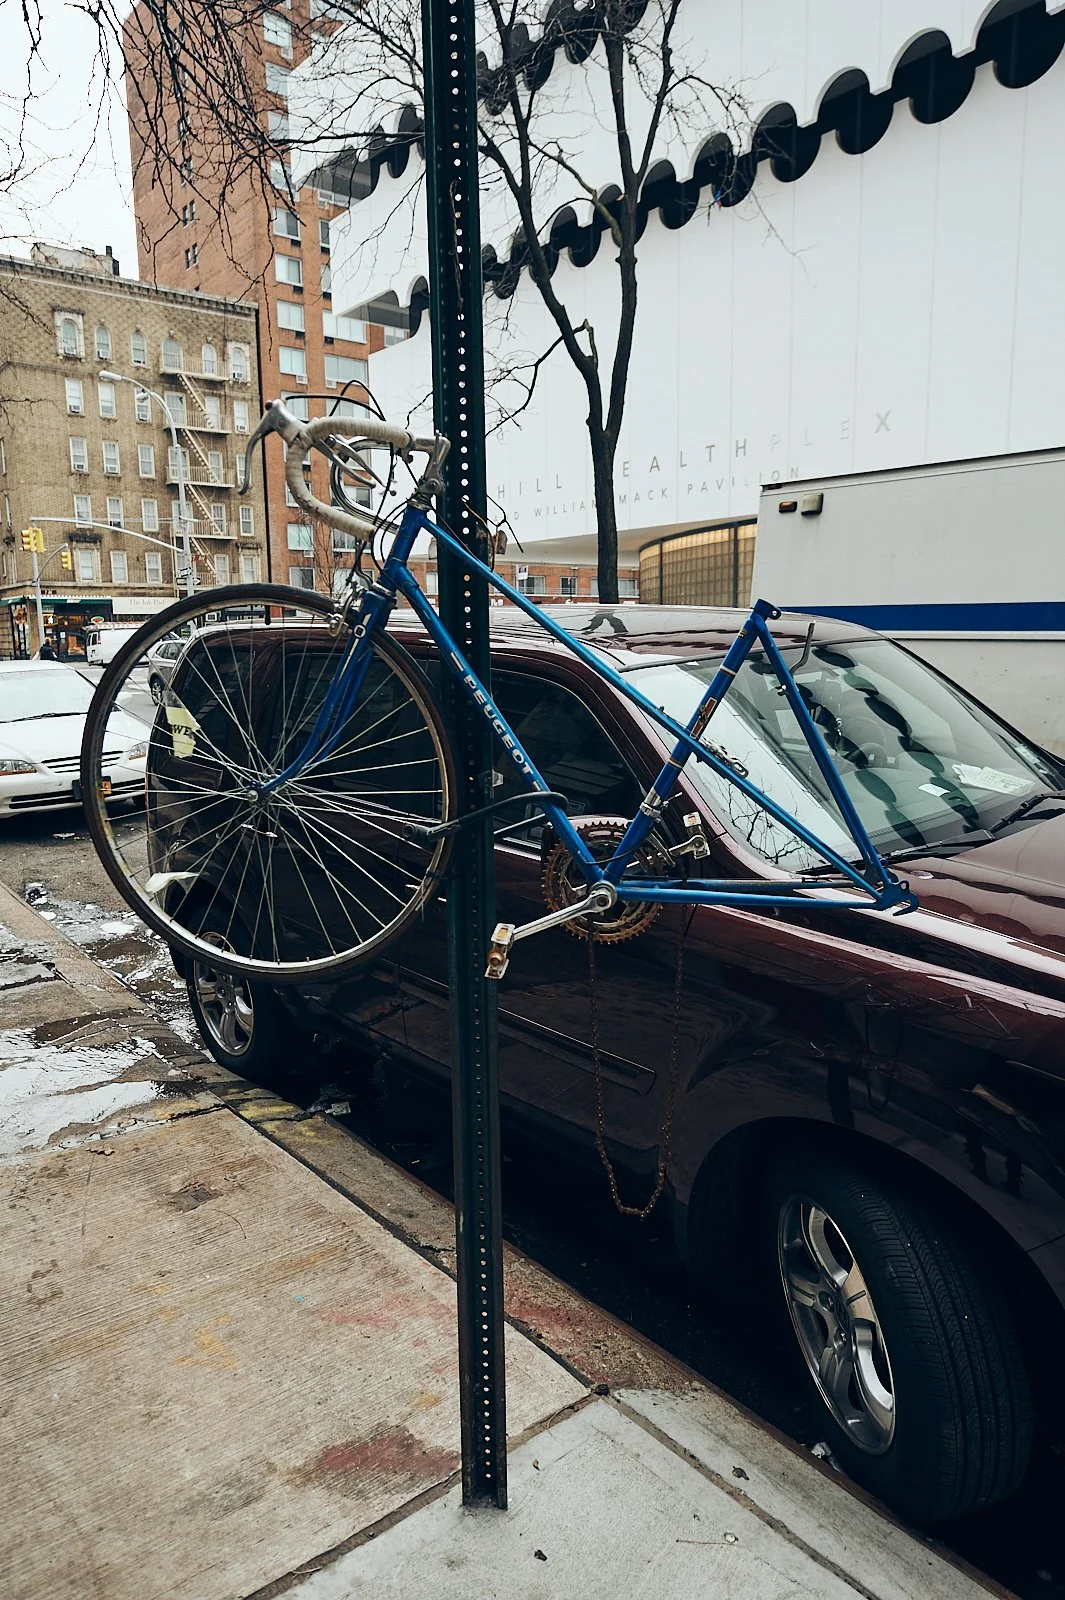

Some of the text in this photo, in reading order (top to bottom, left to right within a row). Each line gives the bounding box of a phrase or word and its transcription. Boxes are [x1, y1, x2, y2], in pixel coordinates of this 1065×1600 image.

[497, 410, 891, 499] HILL EALTHPLEX
[618, 487, 668, 504] MACK
[687, 467, 800, 494] PAVILION
[464, 675, 534, 774] PEUGEOT
